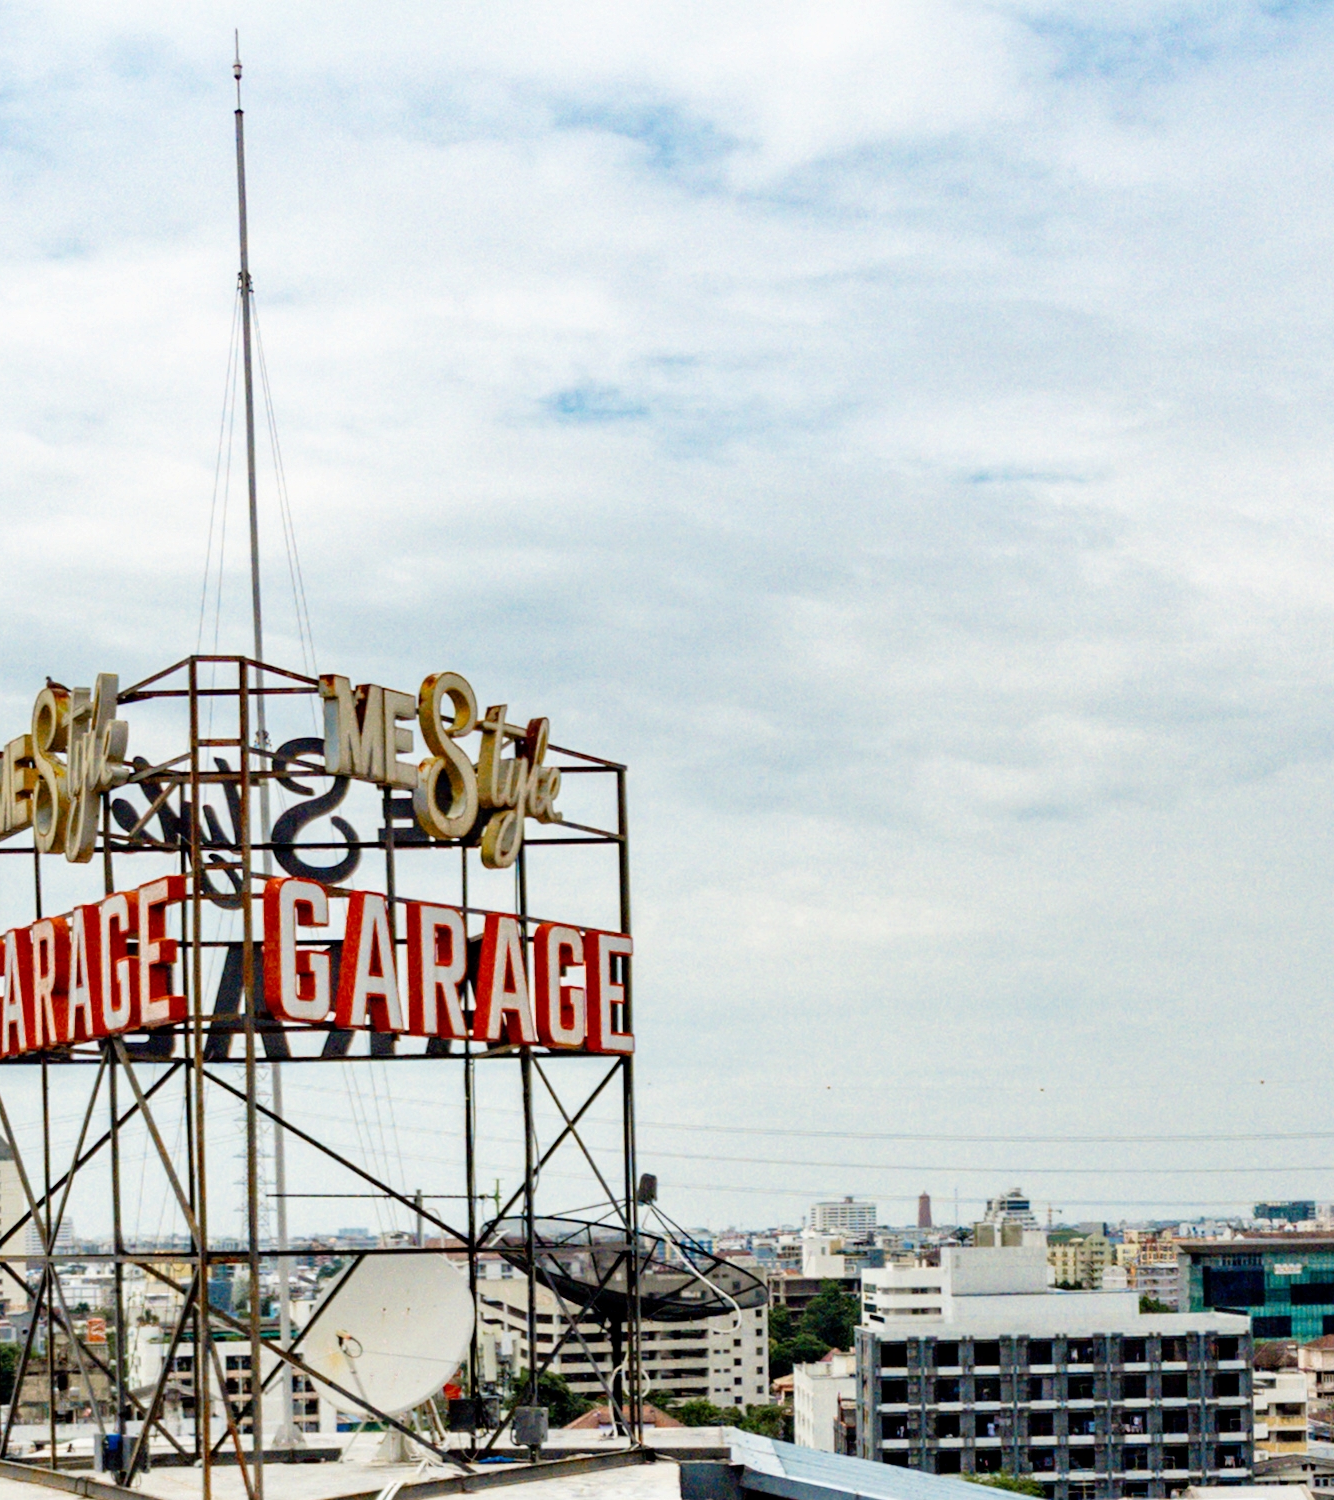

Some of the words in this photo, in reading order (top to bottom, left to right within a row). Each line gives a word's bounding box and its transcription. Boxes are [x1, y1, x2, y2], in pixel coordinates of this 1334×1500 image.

[319, 674, 419, 791] ME
[415, 671, 563, 870] Style
[263, 876, 635, 1055] GARAGE
